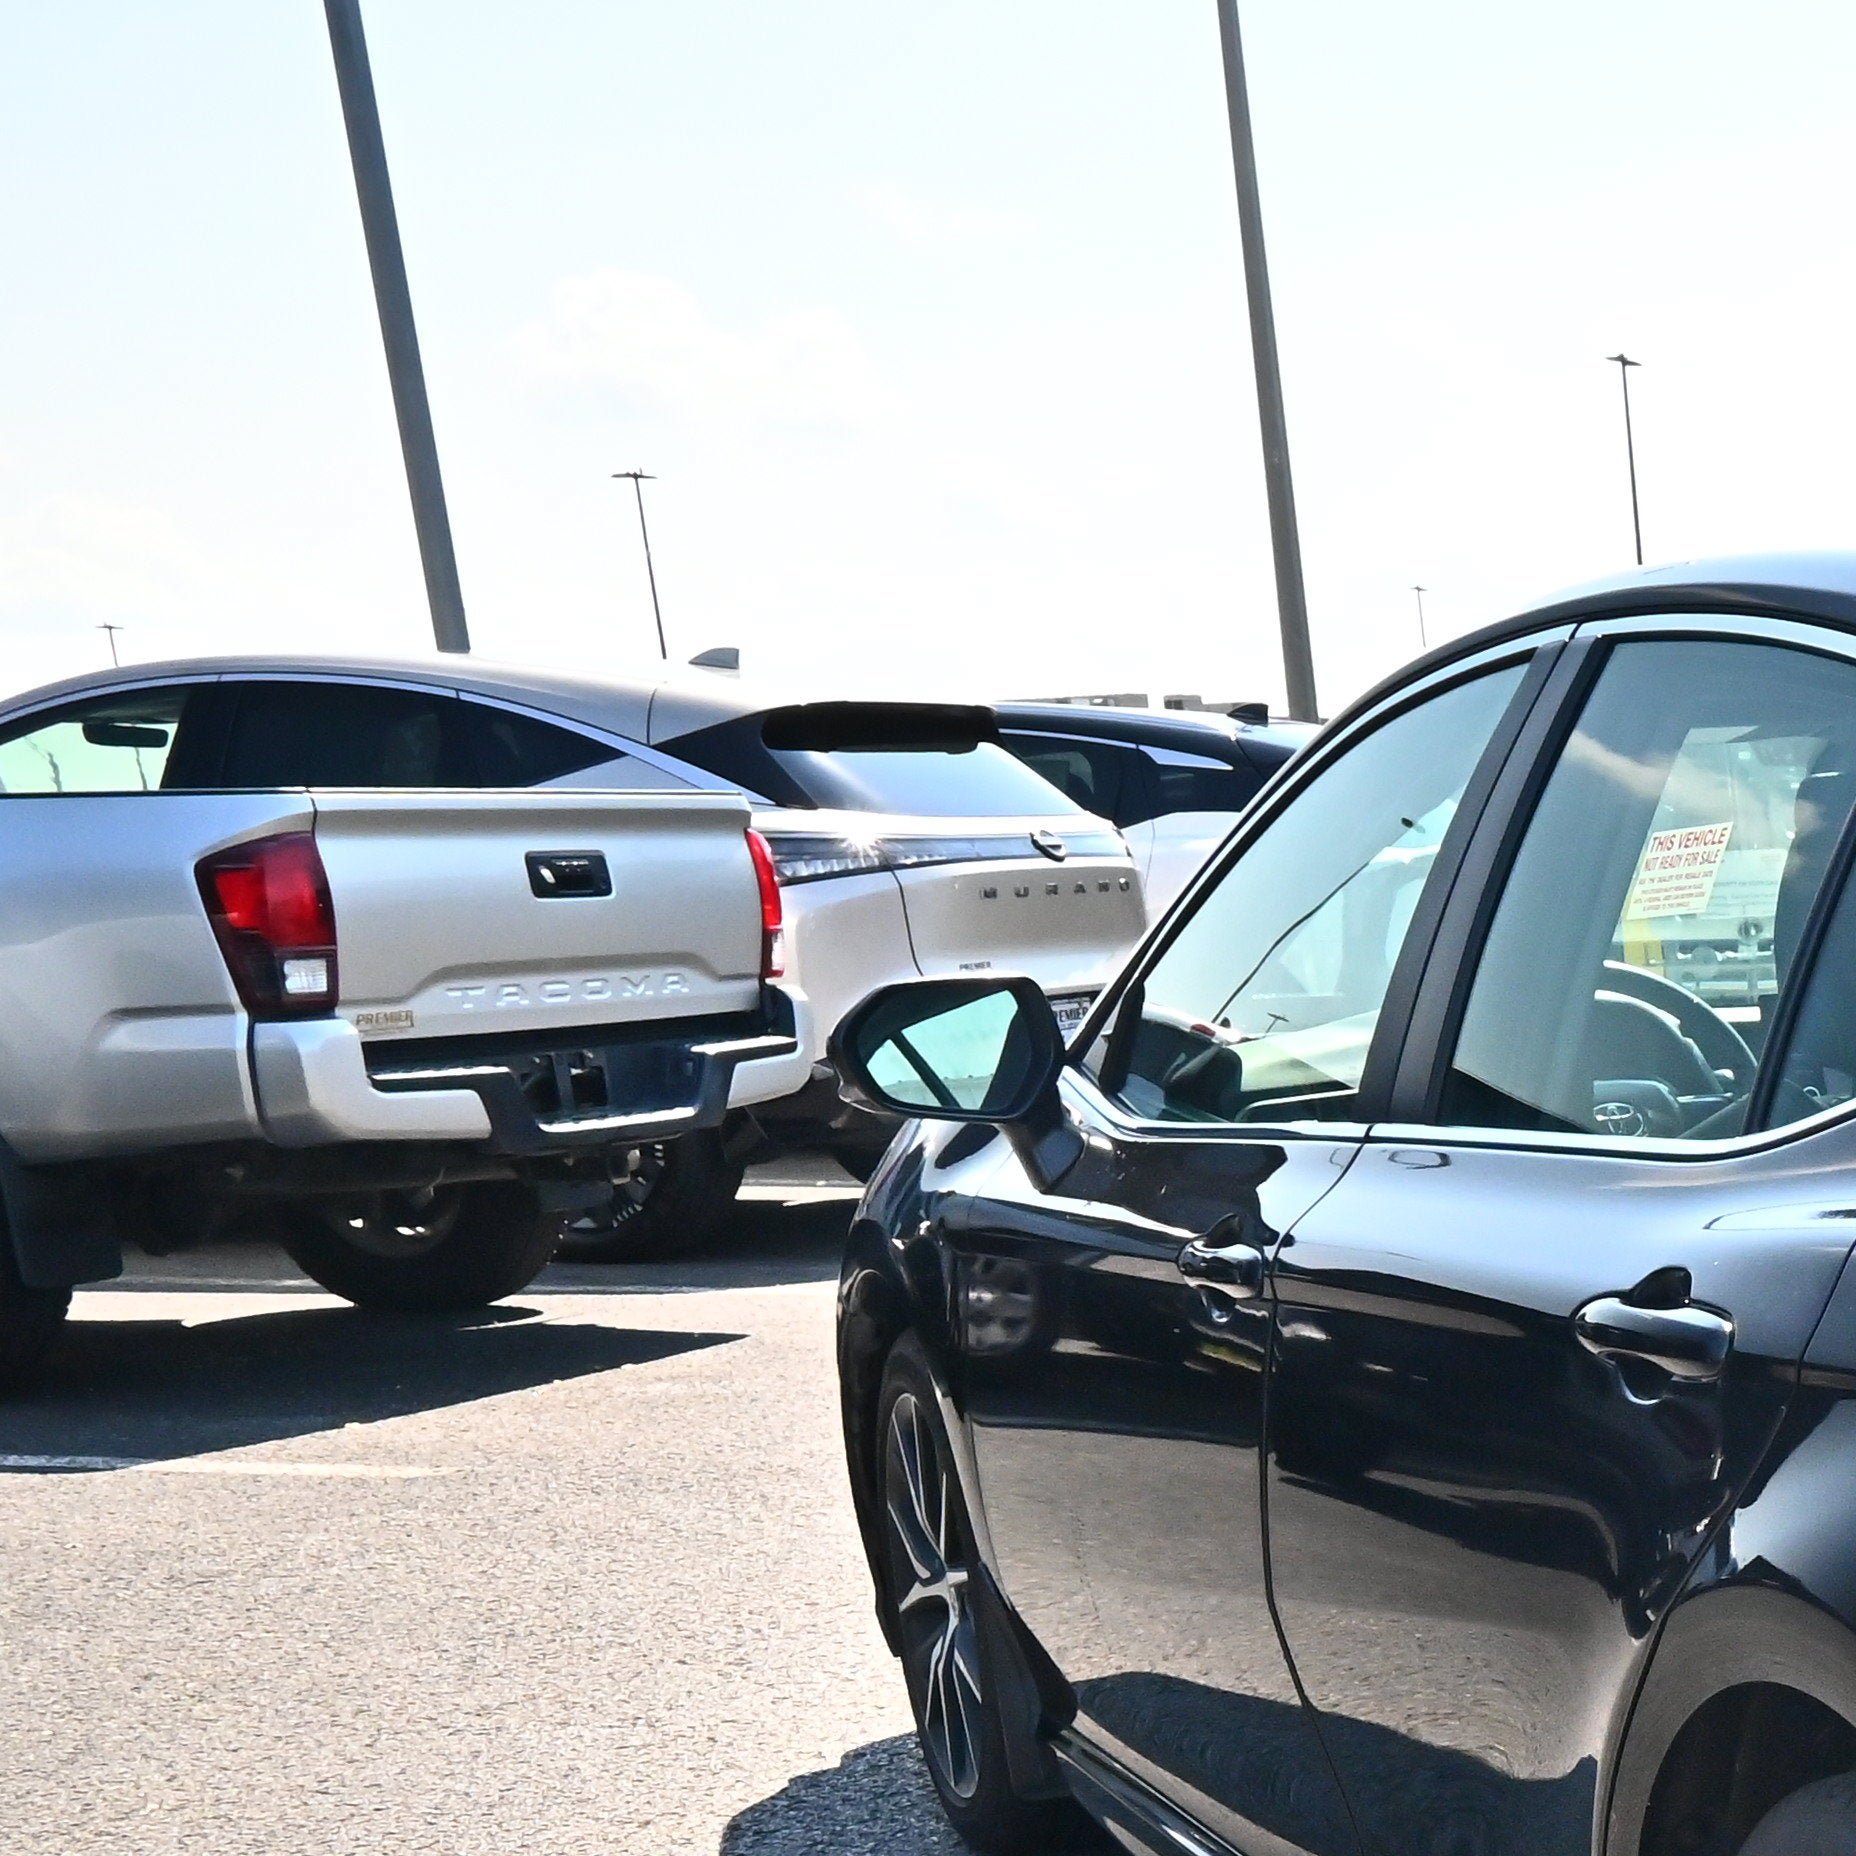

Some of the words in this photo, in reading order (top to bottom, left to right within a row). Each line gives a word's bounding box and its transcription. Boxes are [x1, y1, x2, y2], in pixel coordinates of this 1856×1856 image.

[1650, 834, 1677, 853] THIS
[1678, 827, 1728, 850] VEHICLE
[1700, 849, 1720, 866] SALE
[980, 877, 1130, 899] MURANO
[445, 972, 690, 1009] TACOMA
